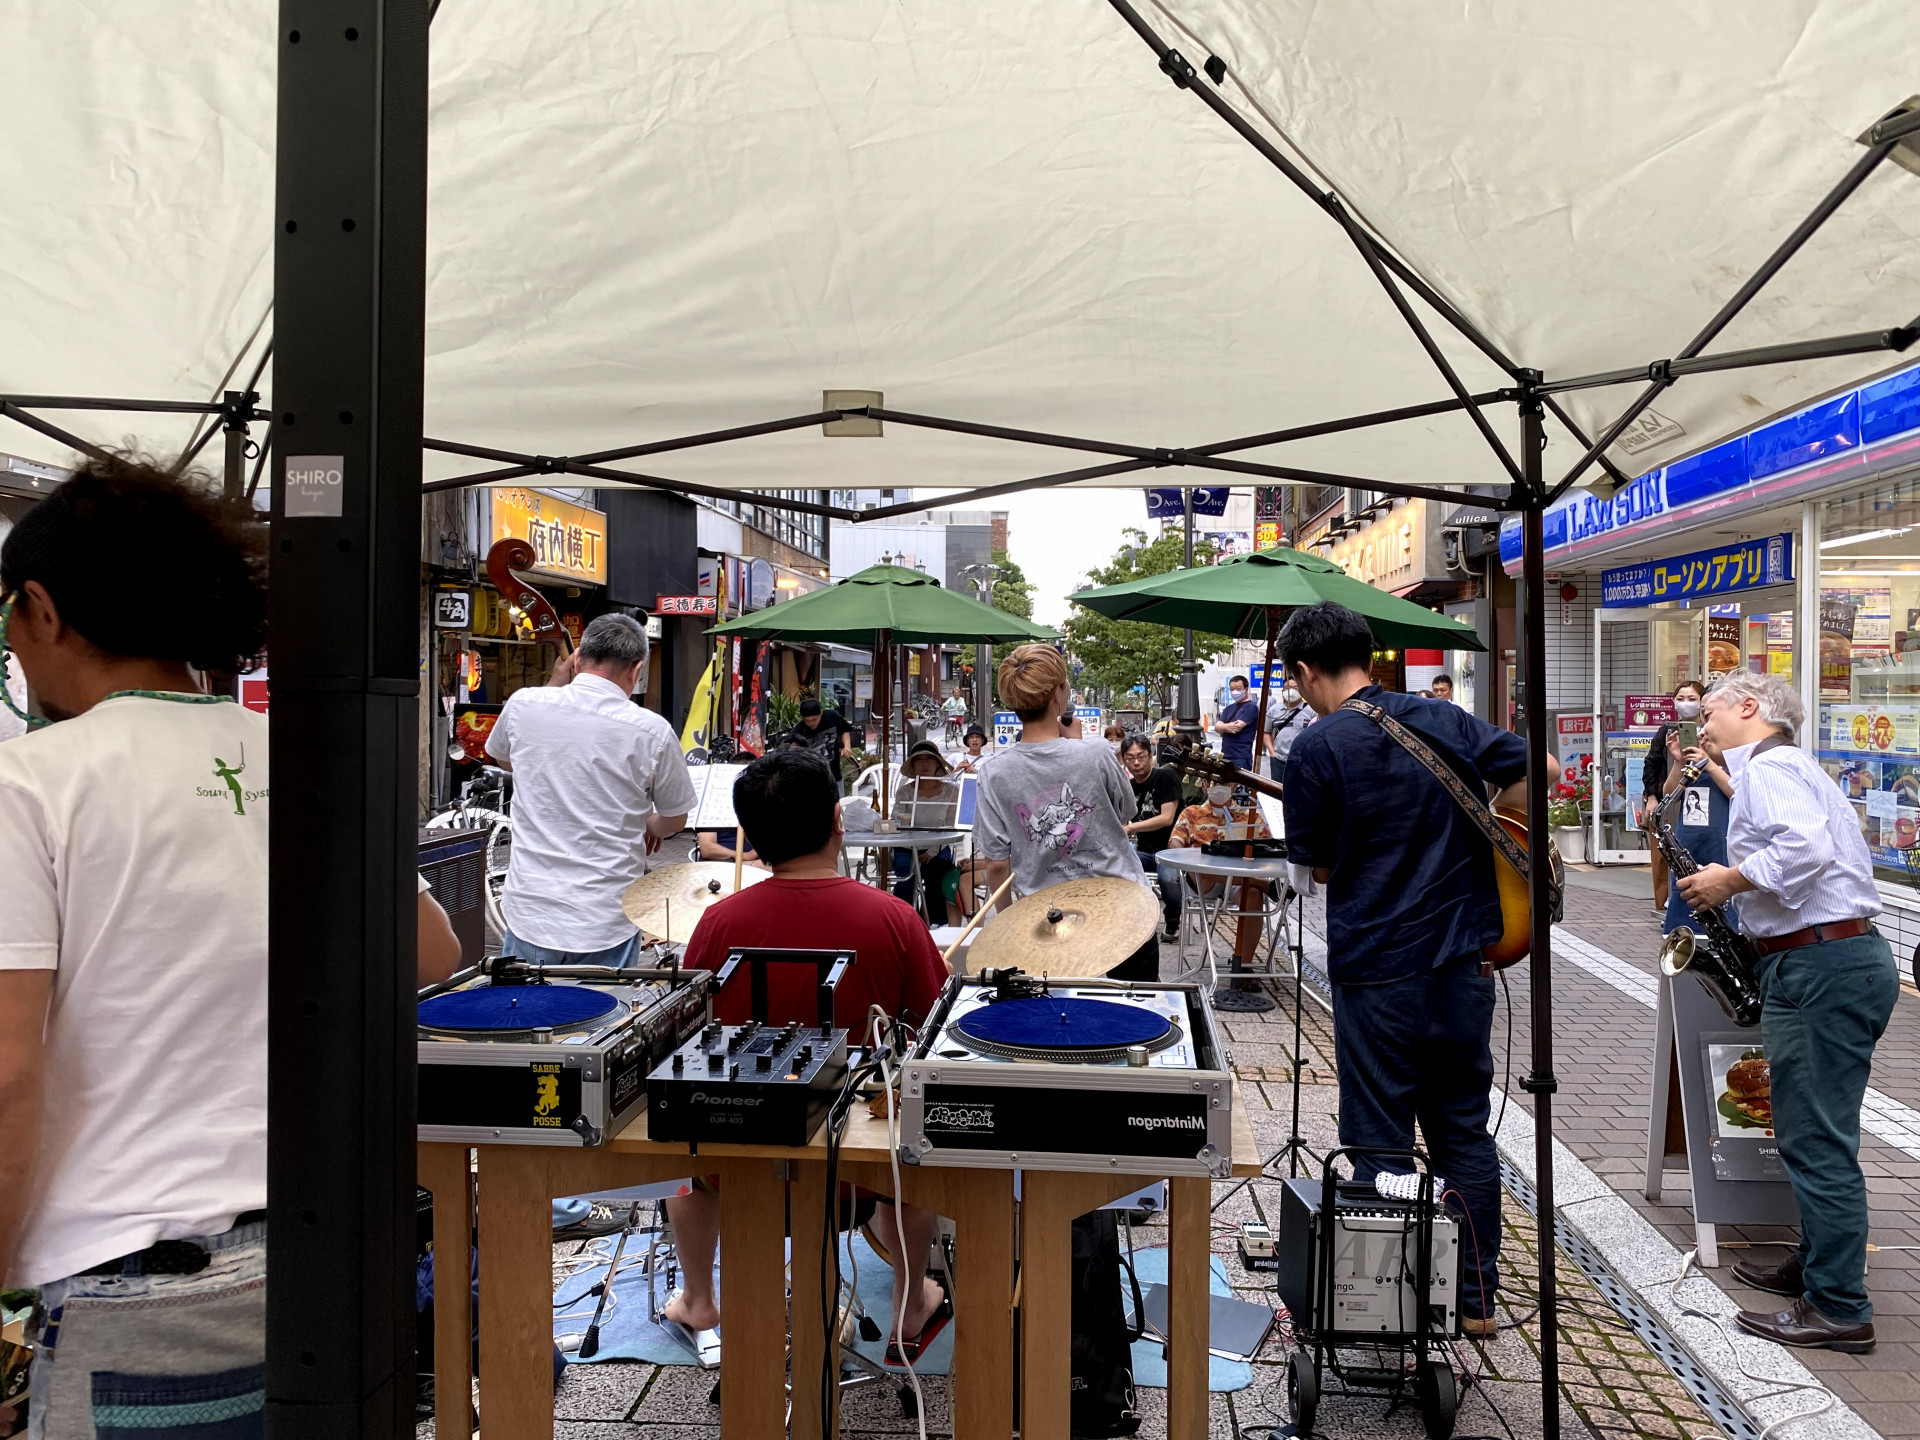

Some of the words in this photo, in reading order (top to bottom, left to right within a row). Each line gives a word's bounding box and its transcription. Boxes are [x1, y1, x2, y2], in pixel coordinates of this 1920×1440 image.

[287, 470, 342, 485] SHIRO
[1163, 499, 1181, 507] Ave.
[1207, 499, 1224, 507] Ave.
[1569, 469, 1663, 541] LAWSON
[1455, 514, 1488, 525] ullica
[528, 518, 602, 572] 府内横丁
[1654, 547, 1762, 595] ローソンアプリ
[440, 599, 465, 619] 牛角
[1562, 715, 1614, 732] 銀行AM
[532, 1064, 560, 1073] SABRE
[690, 1091, 763, 1106] Pioneer
[533, 1116, 561, 1126] POSSE
[709, 1116, 743, 1124] DJM-400
